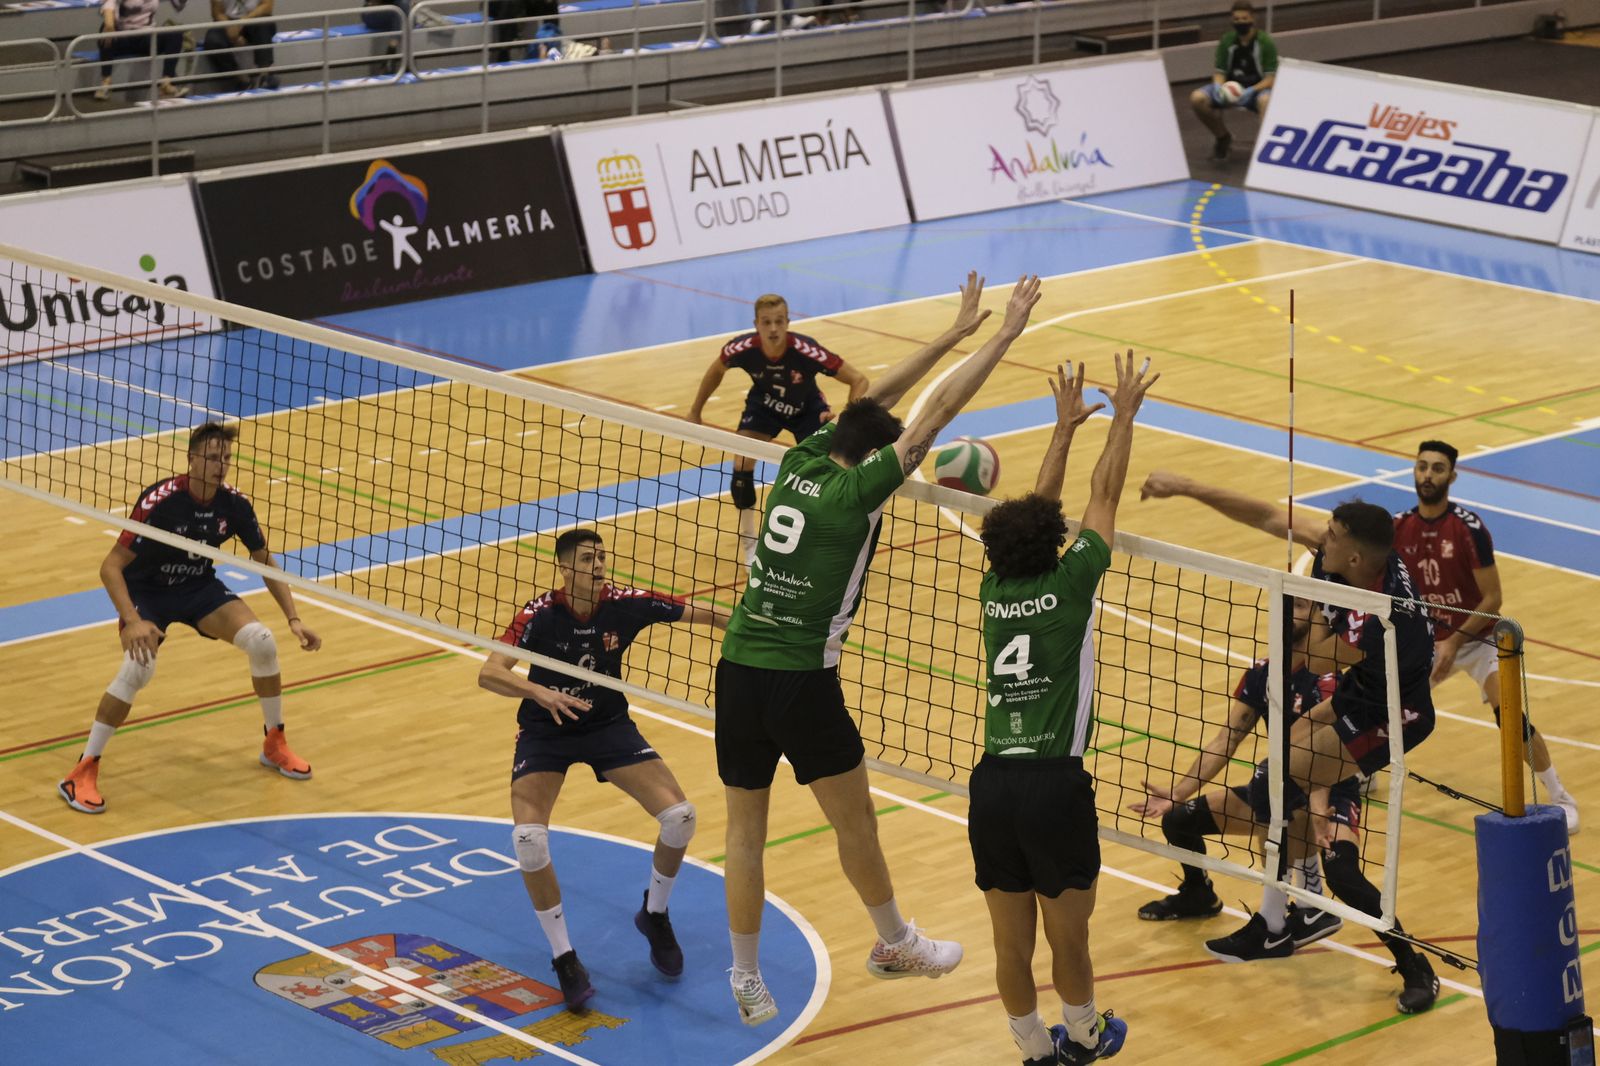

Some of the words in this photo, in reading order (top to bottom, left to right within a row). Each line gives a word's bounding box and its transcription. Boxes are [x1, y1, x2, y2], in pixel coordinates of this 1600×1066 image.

[1368, 102, 1458, 142] Viajes
[689, 118, 872, 193] ALMERÍA
[988, 131, 1114, 184] Andalucía
[426, 204, 555, 252] ALMERÍA
[694, 191, 790, 229] CIUDAD
[764, 504, 806, 555] 9
[1417, 558, 1440, 586] 10
[993, 634, 1034, 680] 4
[319, 824, 458, 867] DE
